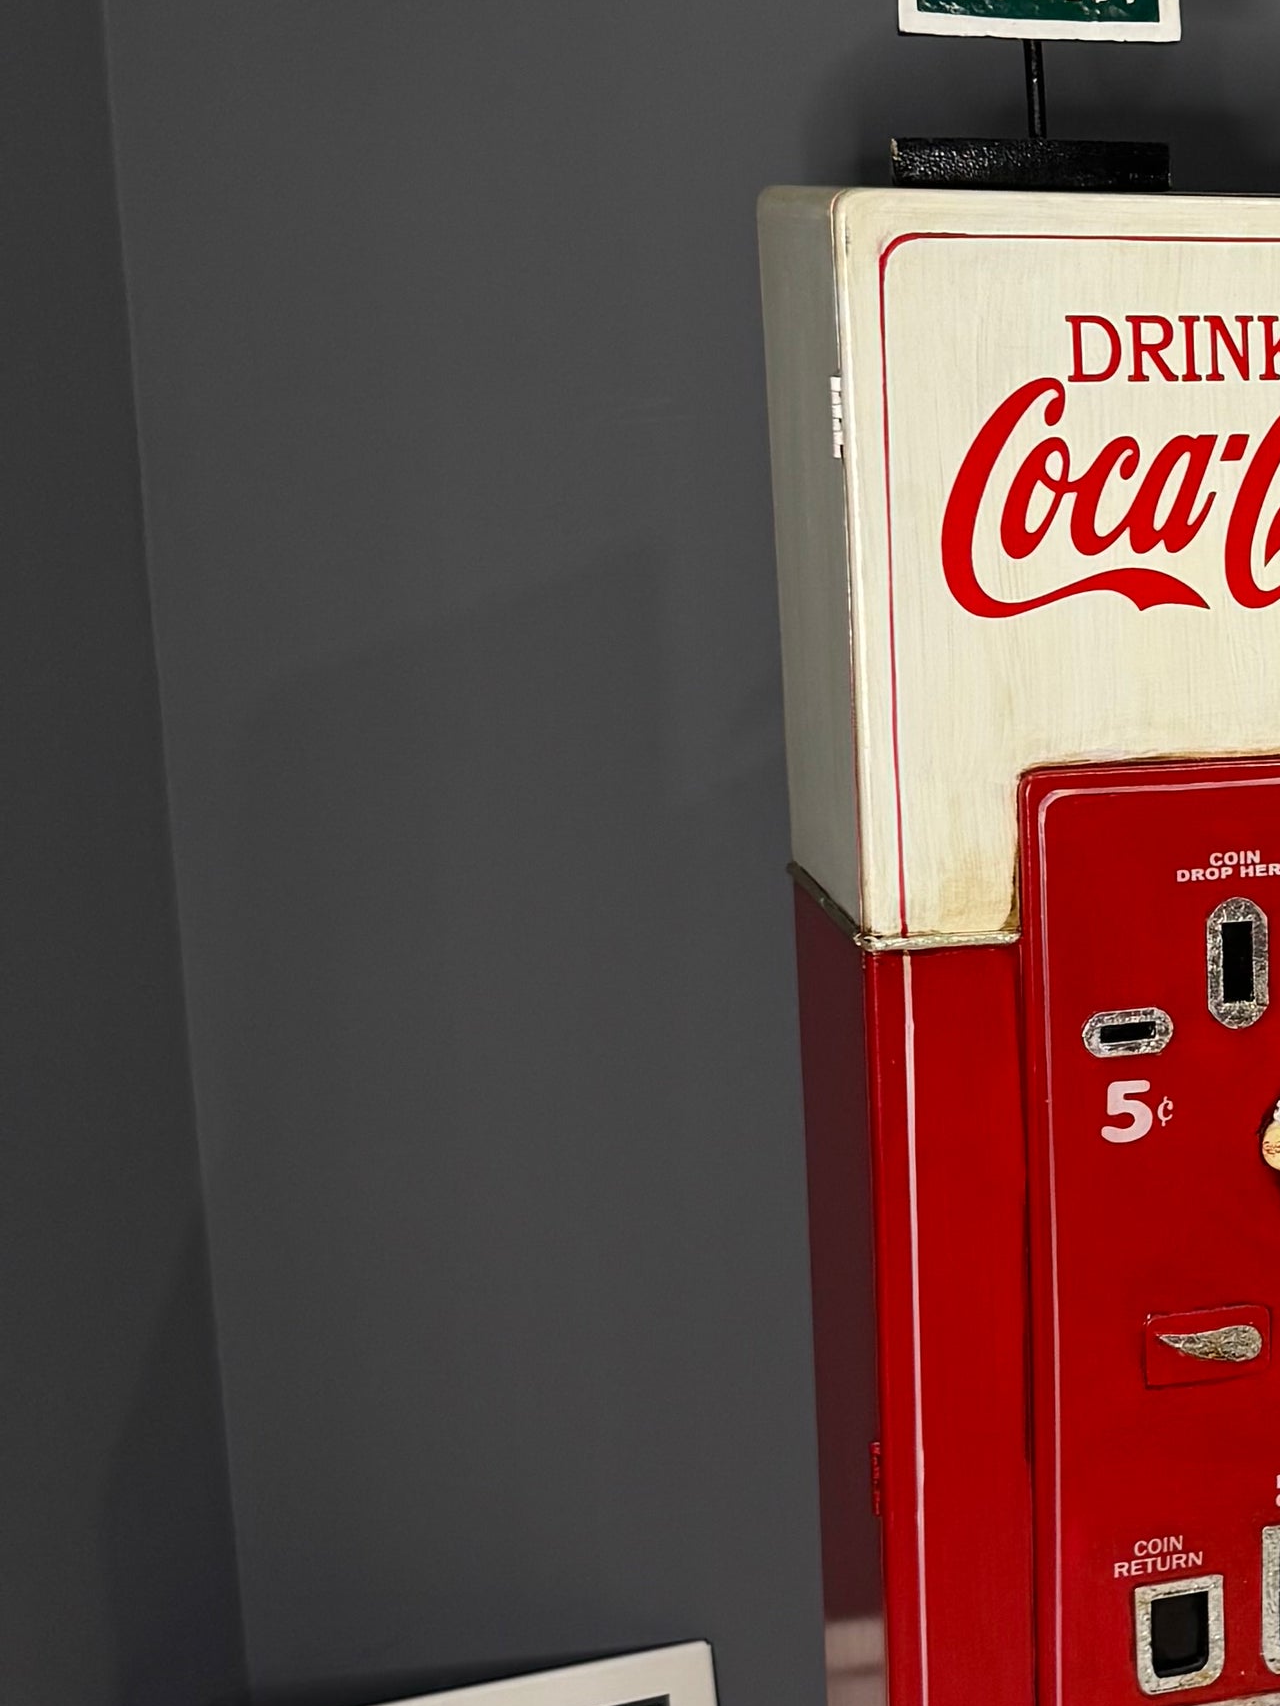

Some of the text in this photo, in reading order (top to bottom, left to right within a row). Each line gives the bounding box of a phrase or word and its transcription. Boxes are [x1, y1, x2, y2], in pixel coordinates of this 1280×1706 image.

[1209, 849, 1261, 867] COIN
[1176, 866, 1233, 883] DROP
[1133, 1534, 1184, 1557] COIN
[1113, 1551, 1204, 1578] RETURN
